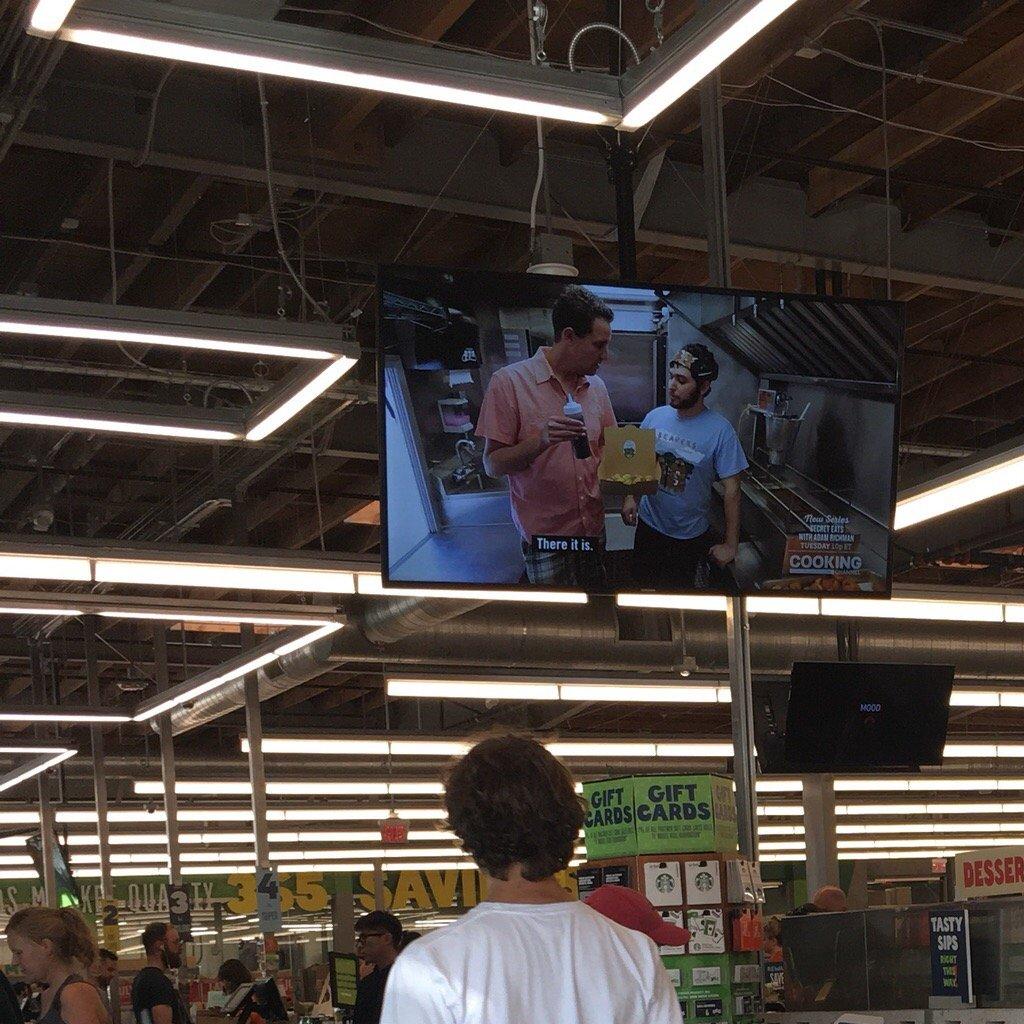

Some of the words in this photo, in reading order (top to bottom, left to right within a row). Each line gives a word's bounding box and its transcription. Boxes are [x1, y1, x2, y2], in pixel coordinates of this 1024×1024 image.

[825, 514, 850, 524] Series
[798, 533, 813, 541] WITH
[810, 525, 830, 533] SECRET
[831, 525, 845, 534] EATS
[537, 537, 568, 551] There
[570, 539, 579, 551] it
[581, 539, 594, 552] is.
[800, 542, 830, 550] TUESDAY
[789, 554, 862, 570] COOKING
[859, 703, 881, 712] MOOD
[591, 787, 624, 809] GIFT
[647, 784, 698, 803] GIFT
[584, 805, 633, 828] CARDS
[636, 802, 712, 822] CARDS
[257, 873, 279, 899] 4
[128, 881, 213, 913] QUATY
[169, 890, 189, 914] 3
[103, 904, 118, 925] 2
[930, 916, 963, 933] TASTY
[937, 934, 959, 951] SIPS
